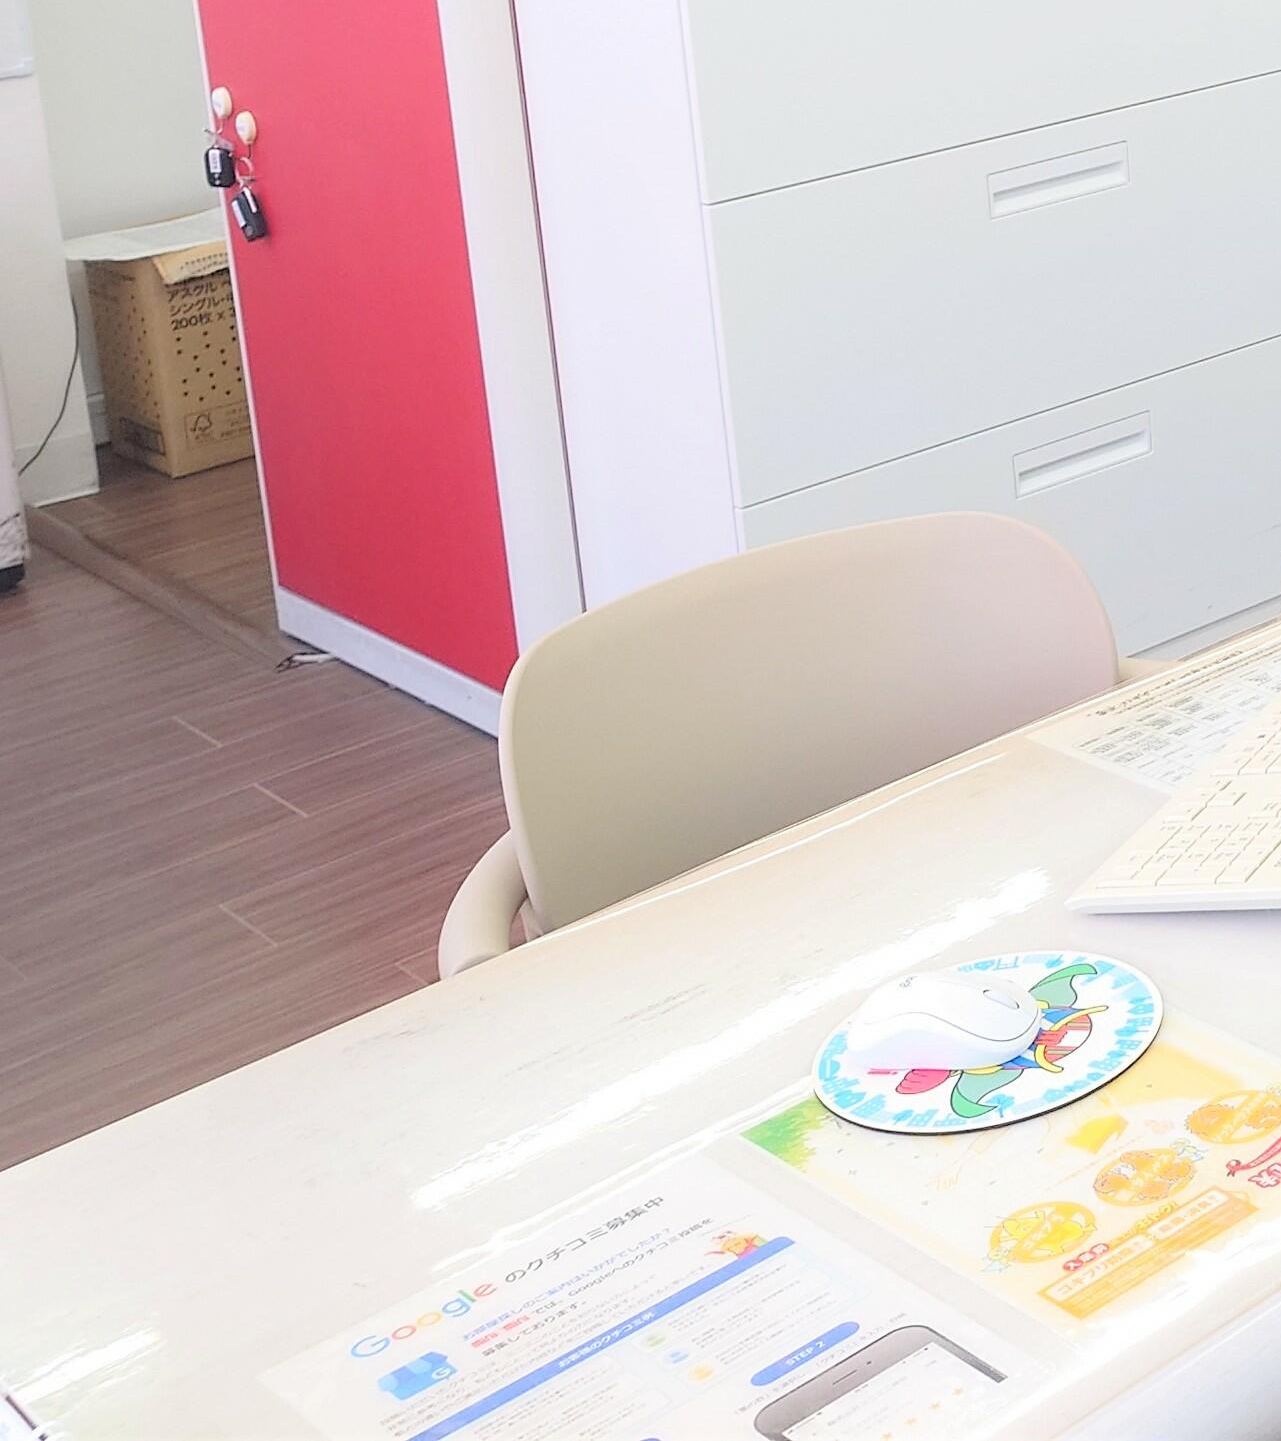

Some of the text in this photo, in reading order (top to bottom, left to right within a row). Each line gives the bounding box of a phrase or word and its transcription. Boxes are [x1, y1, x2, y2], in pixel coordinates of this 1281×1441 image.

[167, 281, 218, 303] アスクル
[349, 1280, 499, 1361] Google
[504, 1194, 666, 1284] のクチコミ募集中
